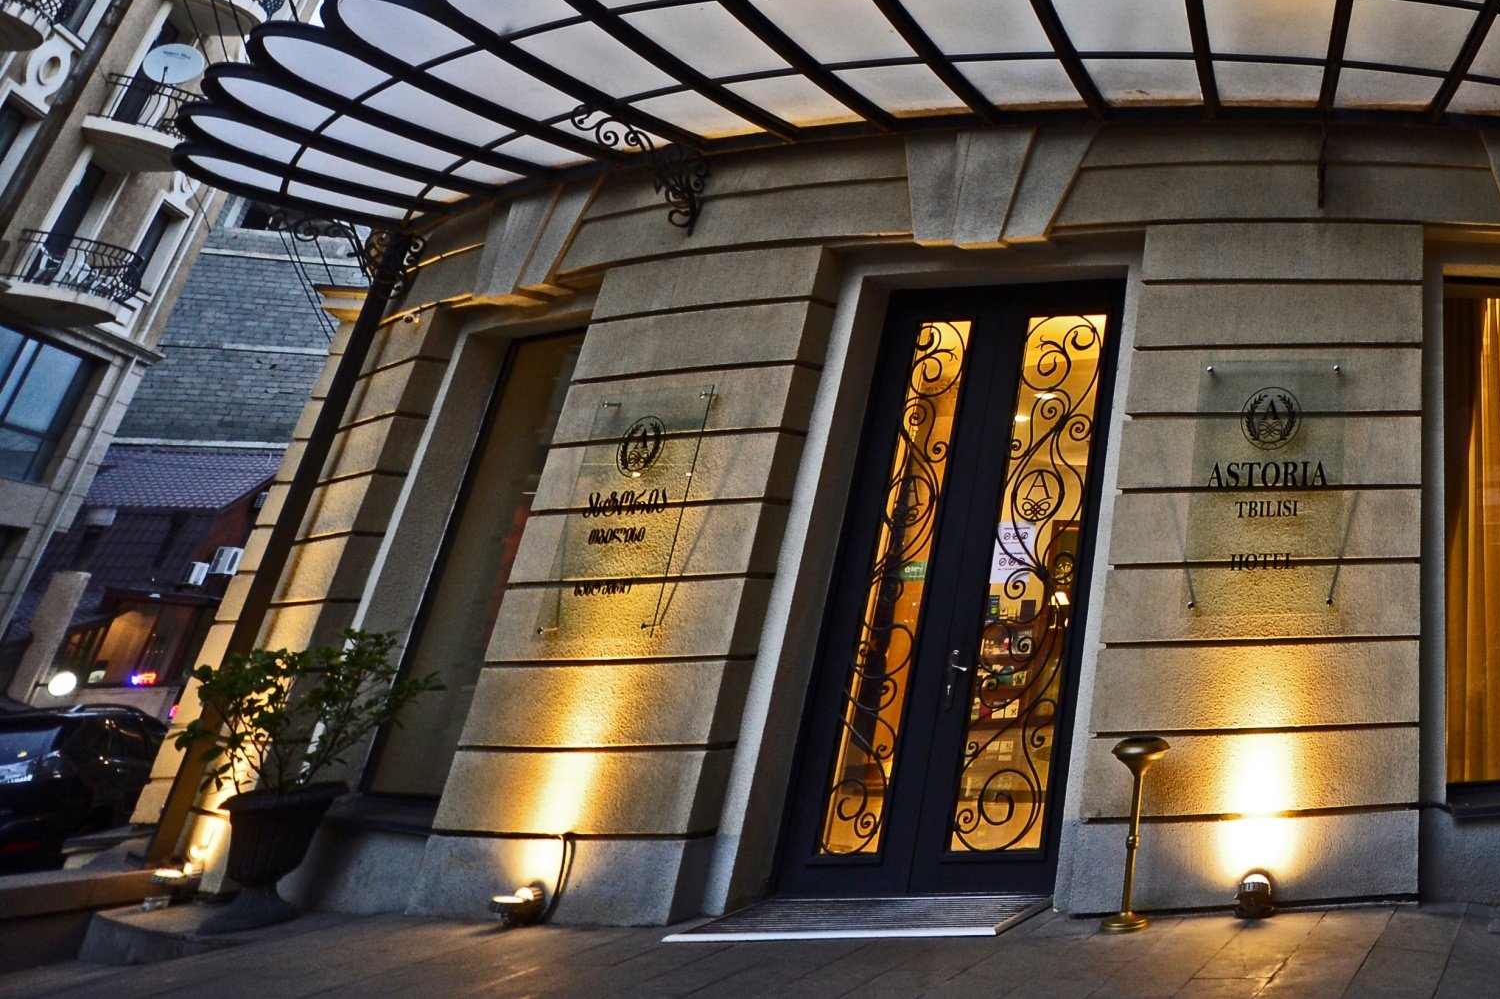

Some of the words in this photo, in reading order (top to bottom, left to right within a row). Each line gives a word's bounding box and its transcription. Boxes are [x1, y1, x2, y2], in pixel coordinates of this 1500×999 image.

[1207, 461, 1328, 488] ASTORIA
[1235, 500, 1298, 518] TBILISI
[1230, 553, 1295, 571] HOTEL
